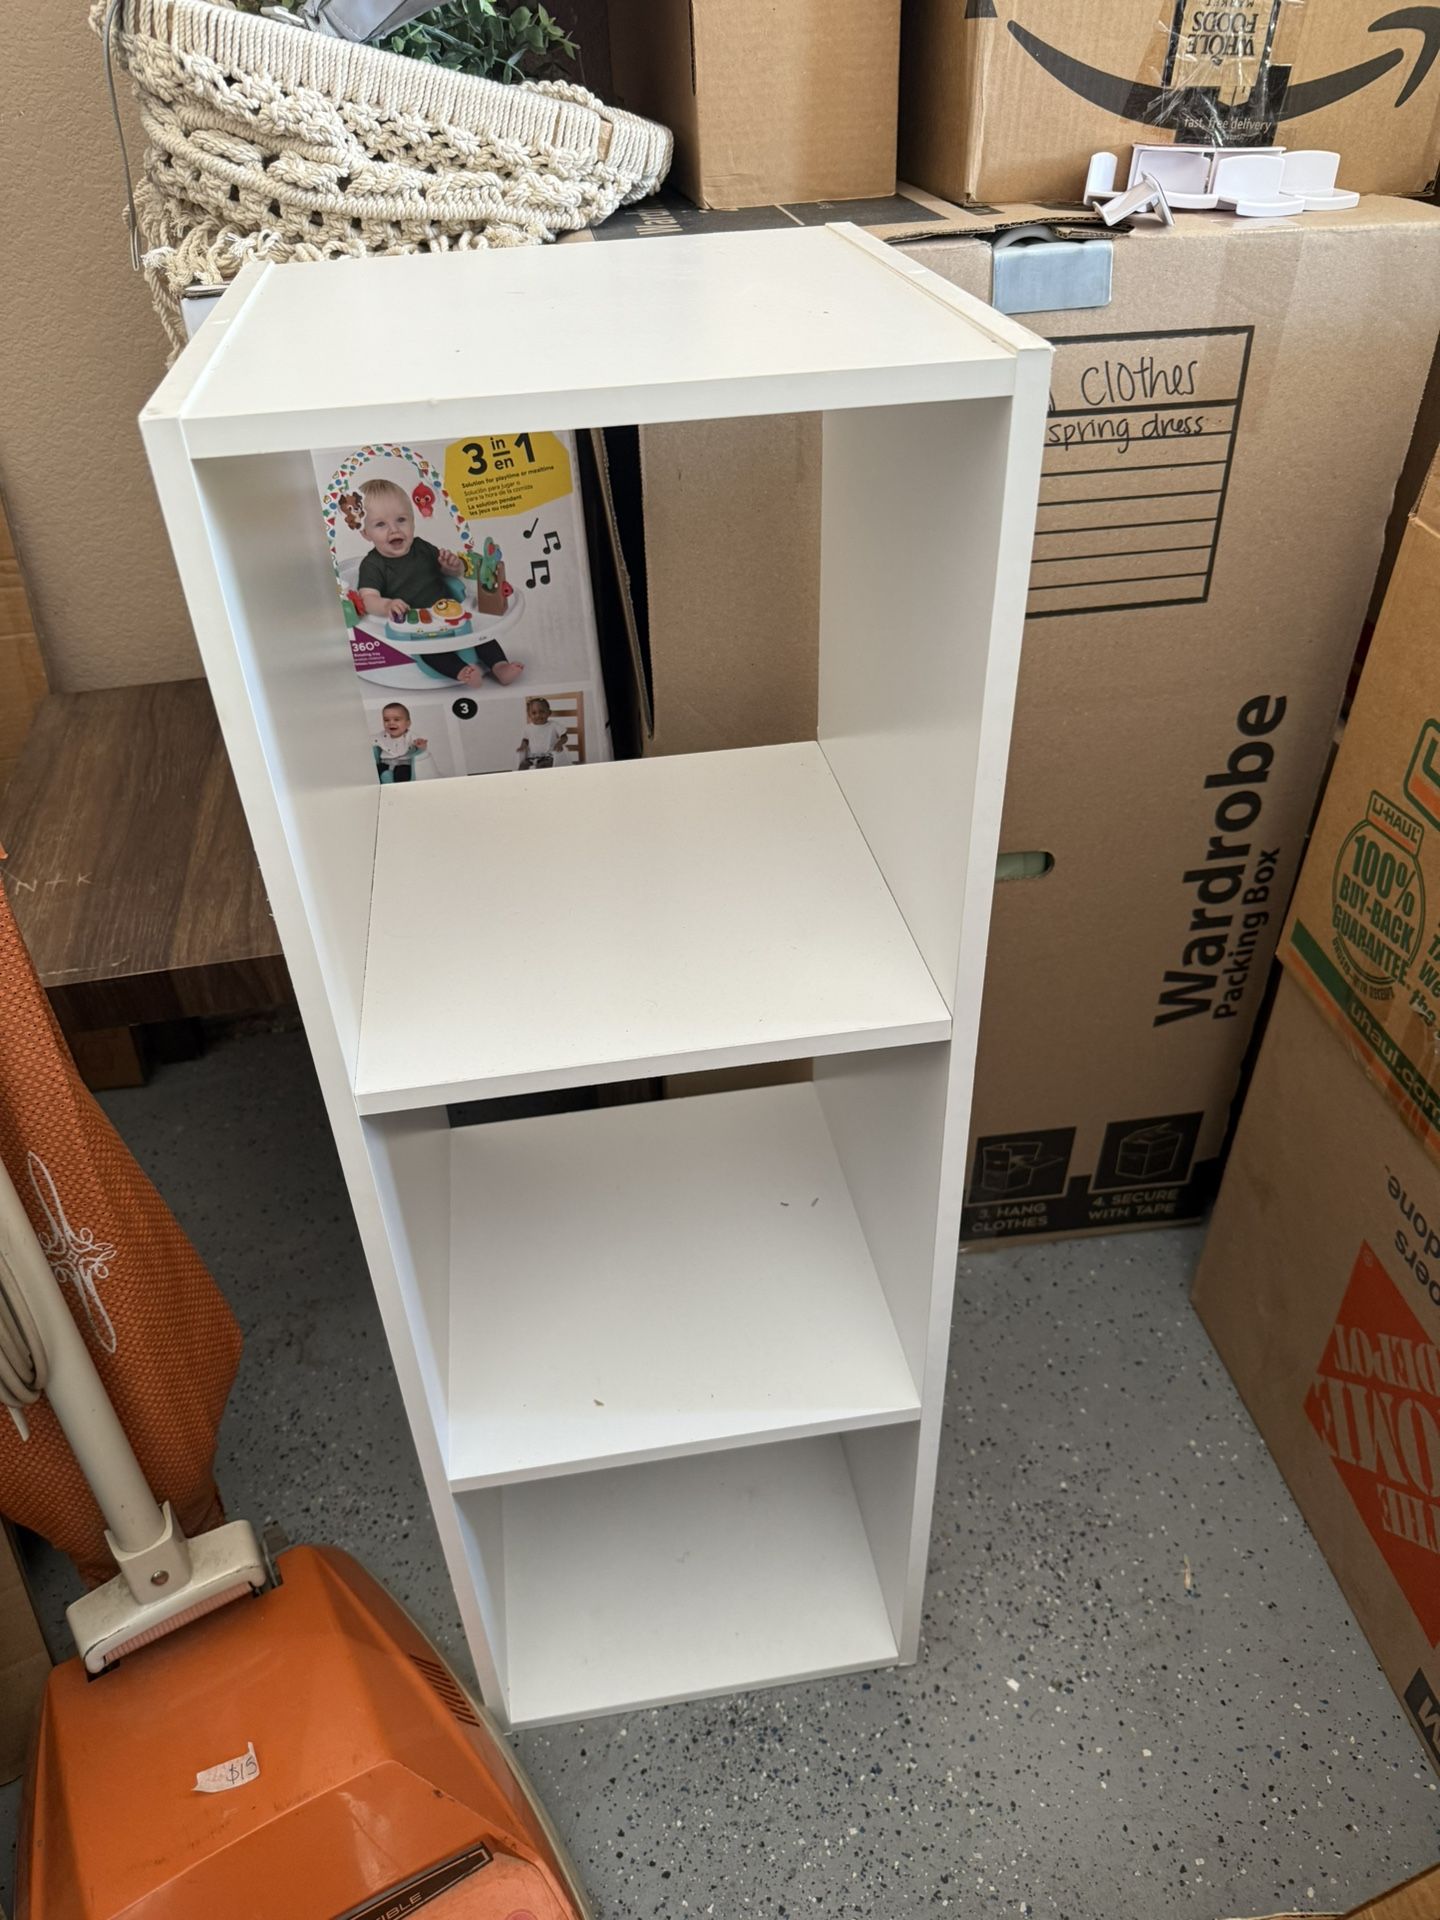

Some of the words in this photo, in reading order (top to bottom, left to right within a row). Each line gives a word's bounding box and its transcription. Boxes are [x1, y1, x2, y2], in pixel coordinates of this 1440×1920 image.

[1192, 11, 1259, 34] FOODS
[1186, 34, 1254, 57] WHOLE
[1208, 117, 1228, 130] free
[1231, 116, 1272, 134] delivery
[1049, 418, 1130, 454] spring
[462, 443, 488, 475] 3
[490, 437, 506, 451] in
[514, 433, 536, 463] 1
[494, 457, 514, 470] en
[460, 703, 470, 714] 3
[1153, 694, 1287, 1027] Wardrobe
[1353, 834, 1416, 917] 100%
[1339, 873, 1415, 954] BUY-BACK
[1212, 911, 1269, 1019] Packing
[1241, 848, 1280, 906] Box
[997, 1202, 1047, 1217] HANG
[1112, 1188, 1179, 1205] SECURE
[971, 1215, 1048, 1232] CLOTHES
[1088, 1206, 1131, 1219] WITH
[1136, 1202, 1176, 1216] TAPE
[1334, 1324, 1440, 1398] DEPOT
[1313, 1376, 1440, 1498] OME
[226, 1755, 257, 1785] $15
